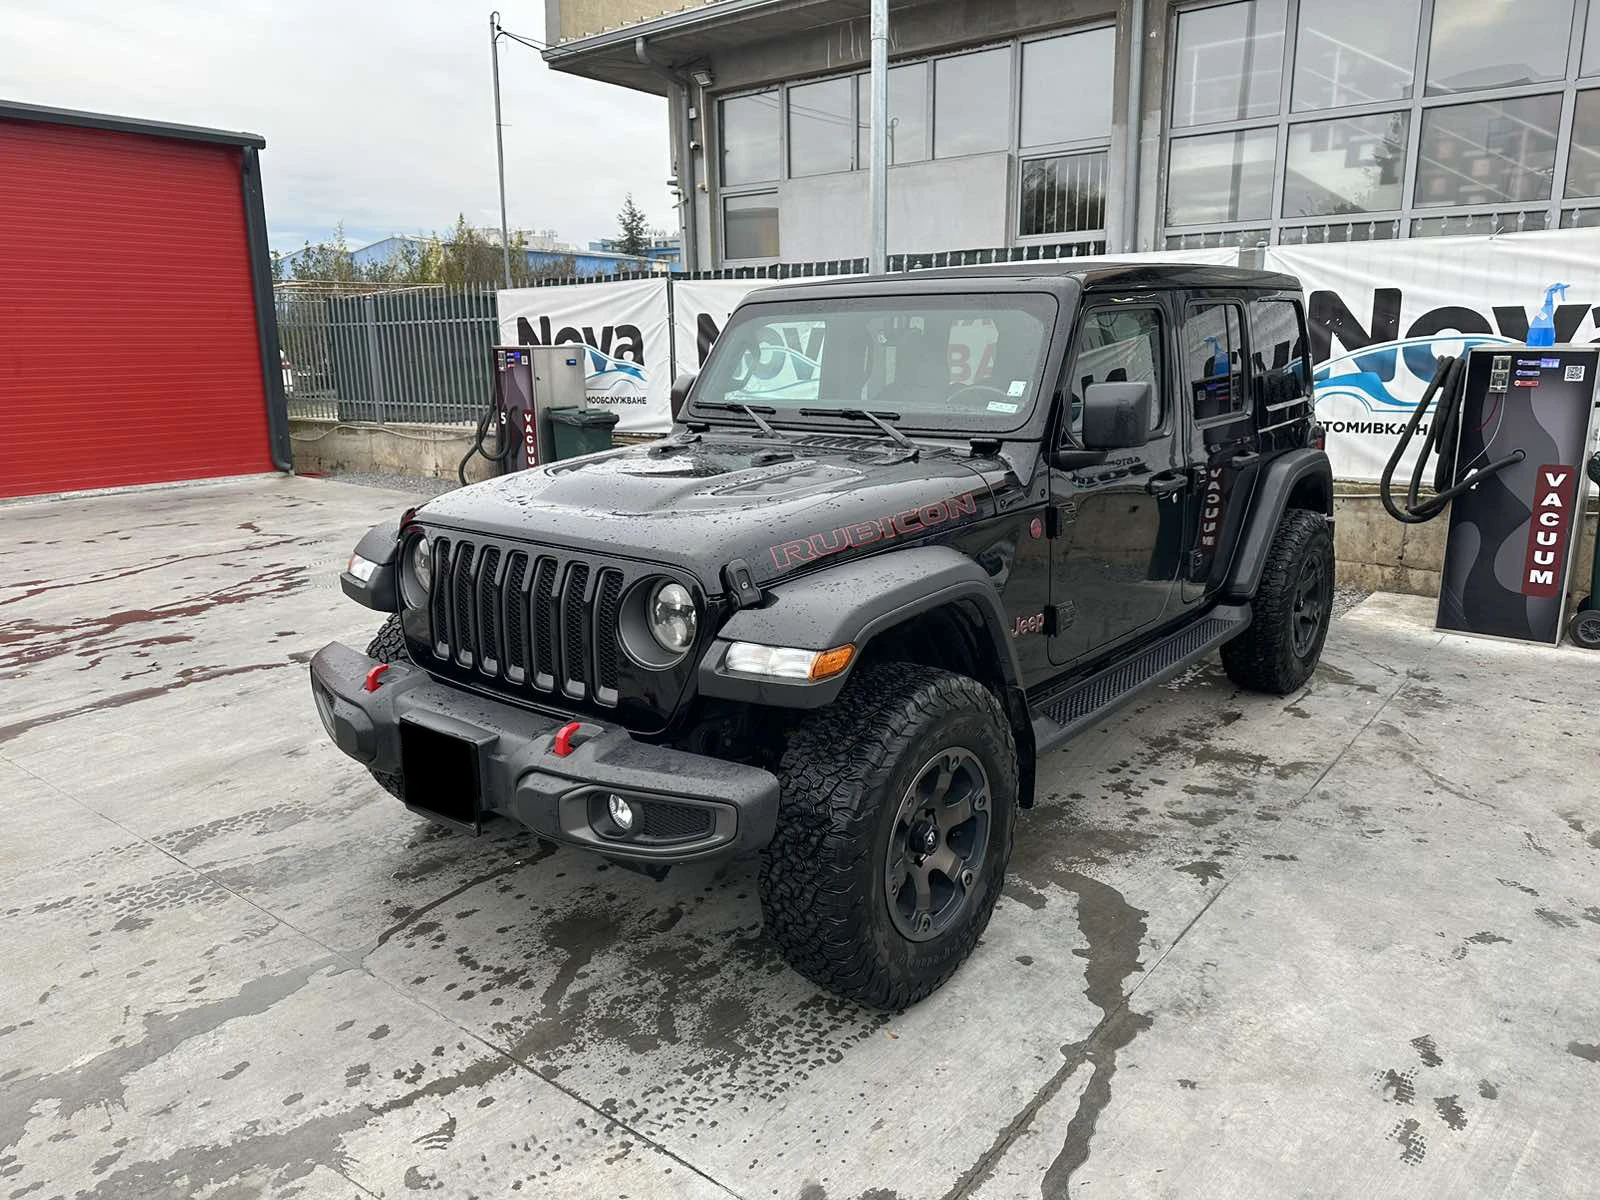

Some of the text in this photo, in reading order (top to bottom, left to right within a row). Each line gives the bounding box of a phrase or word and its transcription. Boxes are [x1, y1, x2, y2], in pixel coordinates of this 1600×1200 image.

[1316, 420, 1408, 435] ТОМИВКА
[769, 492, 977, 569] RUBICON
[1528, 472, 1567, 585] VACUUM
[1010, 612, 1045, 638] Jeep
